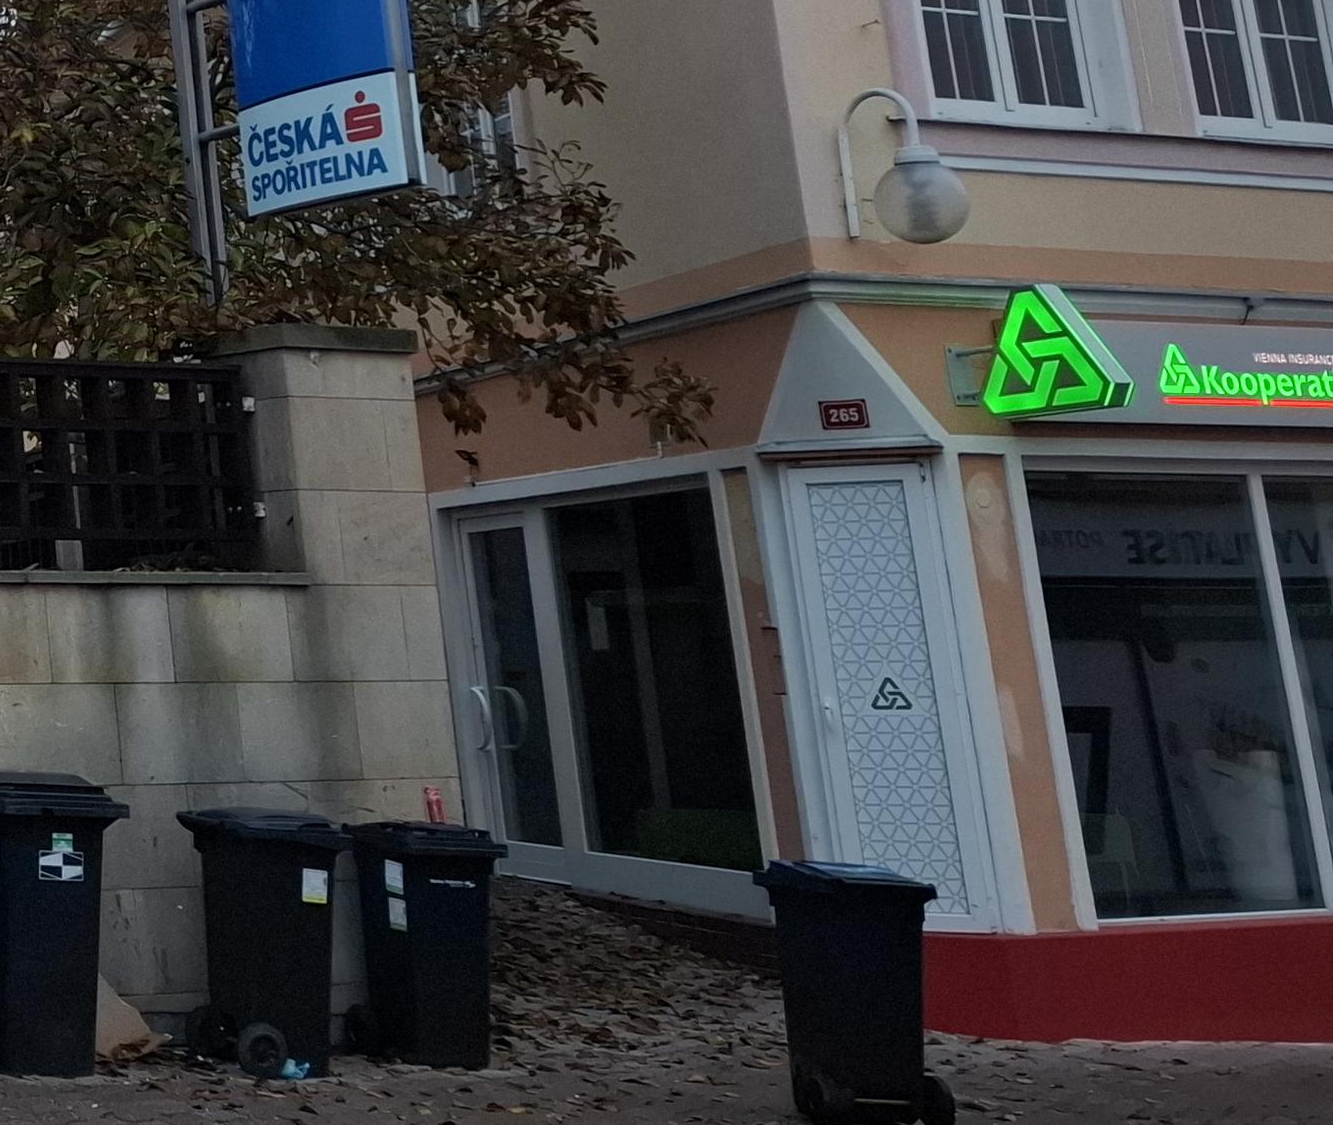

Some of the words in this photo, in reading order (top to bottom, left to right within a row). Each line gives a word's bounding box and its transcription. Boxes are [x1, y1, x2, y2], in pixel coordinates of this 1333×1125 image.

[247, 103, 344, 167] ČESKÁ
[251, 147, 389, 202] SPOŘITELNA
[1252, 353, 1287, 364] VIENNA
[1287, 354, 1333, 365] INSURANC
[829, 407, 859, 423] 265
